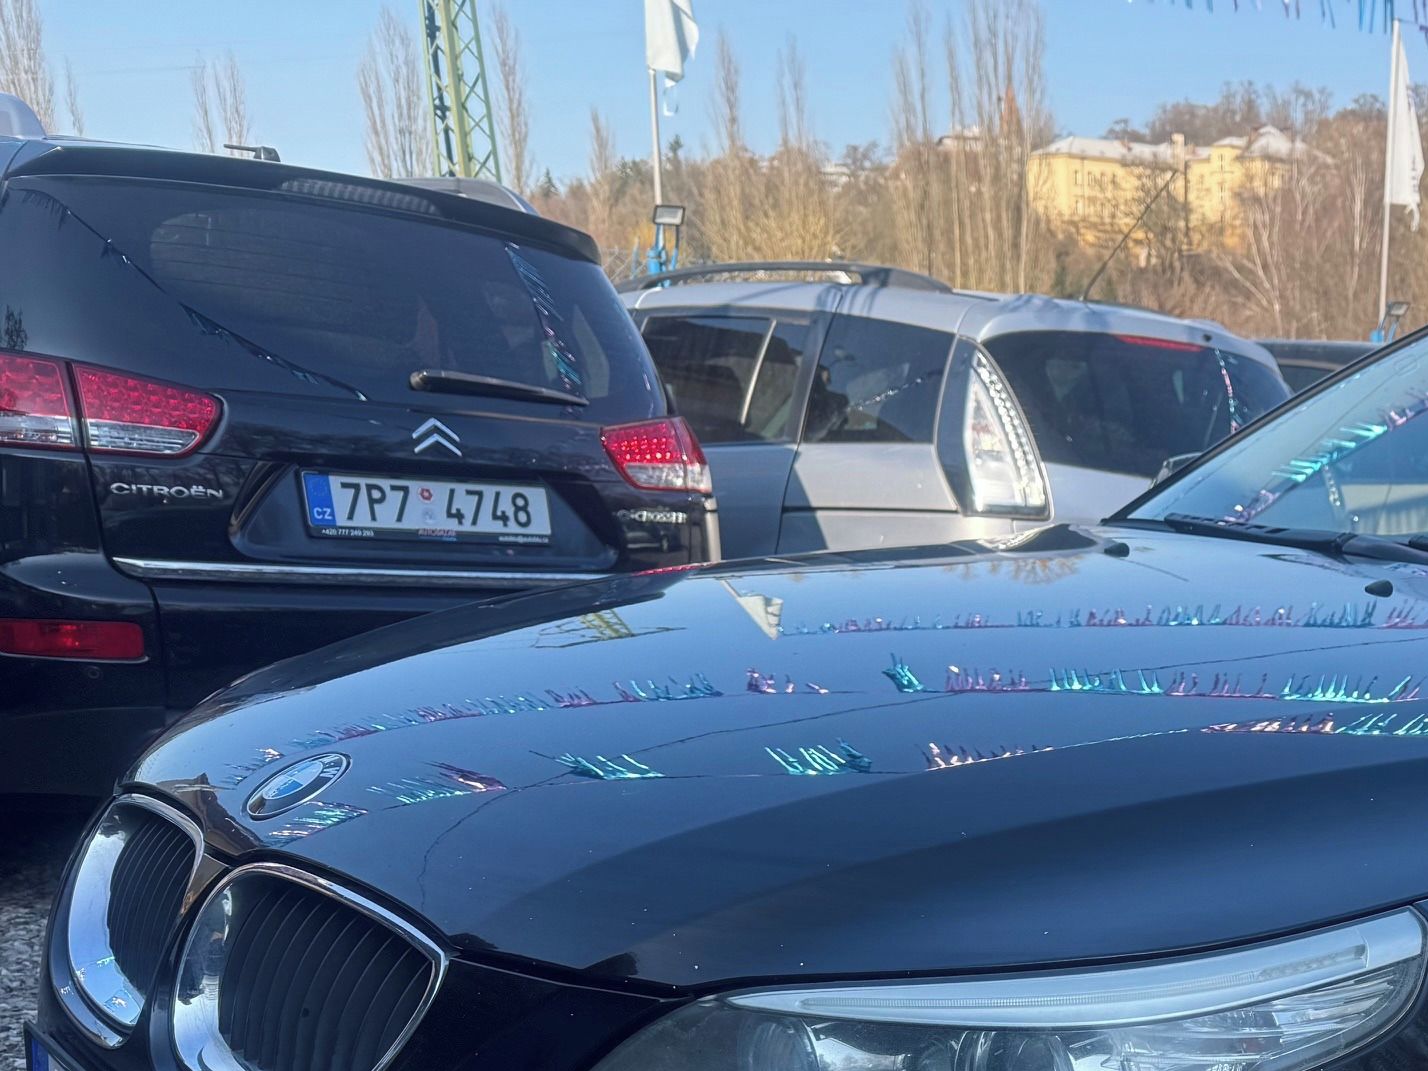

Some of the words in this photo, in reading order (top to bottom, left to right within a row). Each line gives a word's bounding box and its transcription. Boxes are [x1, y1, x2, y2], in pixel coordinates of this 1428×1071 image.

[110, 482, 223, 499] CITROËN
[340, 481, 410, 523] 7P7
[446, 487, 532, 528] 4748
[313, 507, 333, 520] CZ
